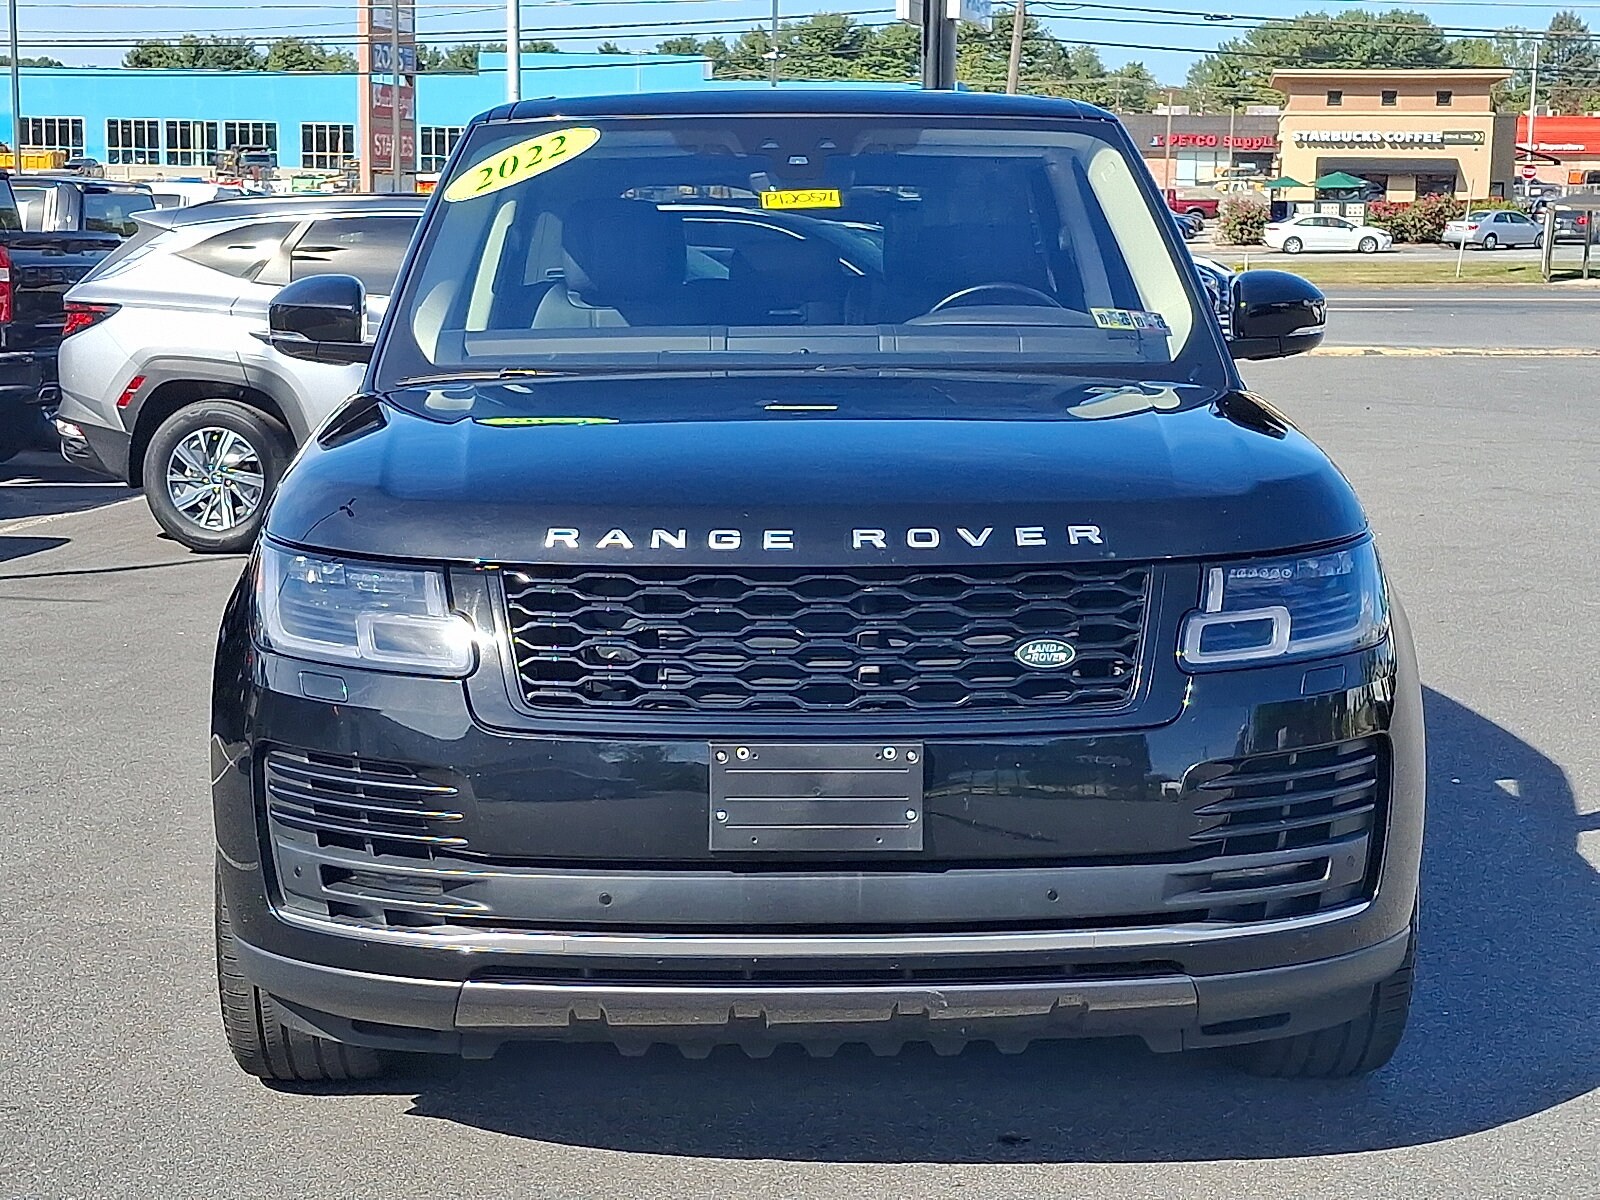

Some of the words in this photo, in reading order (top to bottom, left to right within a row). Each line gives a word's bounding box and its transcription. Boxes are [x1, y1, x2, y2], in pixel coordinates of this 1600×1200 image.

[375, 44, 404, 71] ROS
[374, 133, 414, 157] STAES
[1170, 134, 1216, 147] PETCO
[1223, 135, 1279, 150] Suppli
[1293, 130, 1381, 143] STARBUCKS
[1384, 131, 1442, 144] COFFEE
[476, 136, 566, 191] 2022
[544, 527, 795, 550] RANGE
[851, 524, 1105, 549] ROVER
[1027, 644, 1057, 653] LAND
[1032, 652, 1067, 662] ROVER
